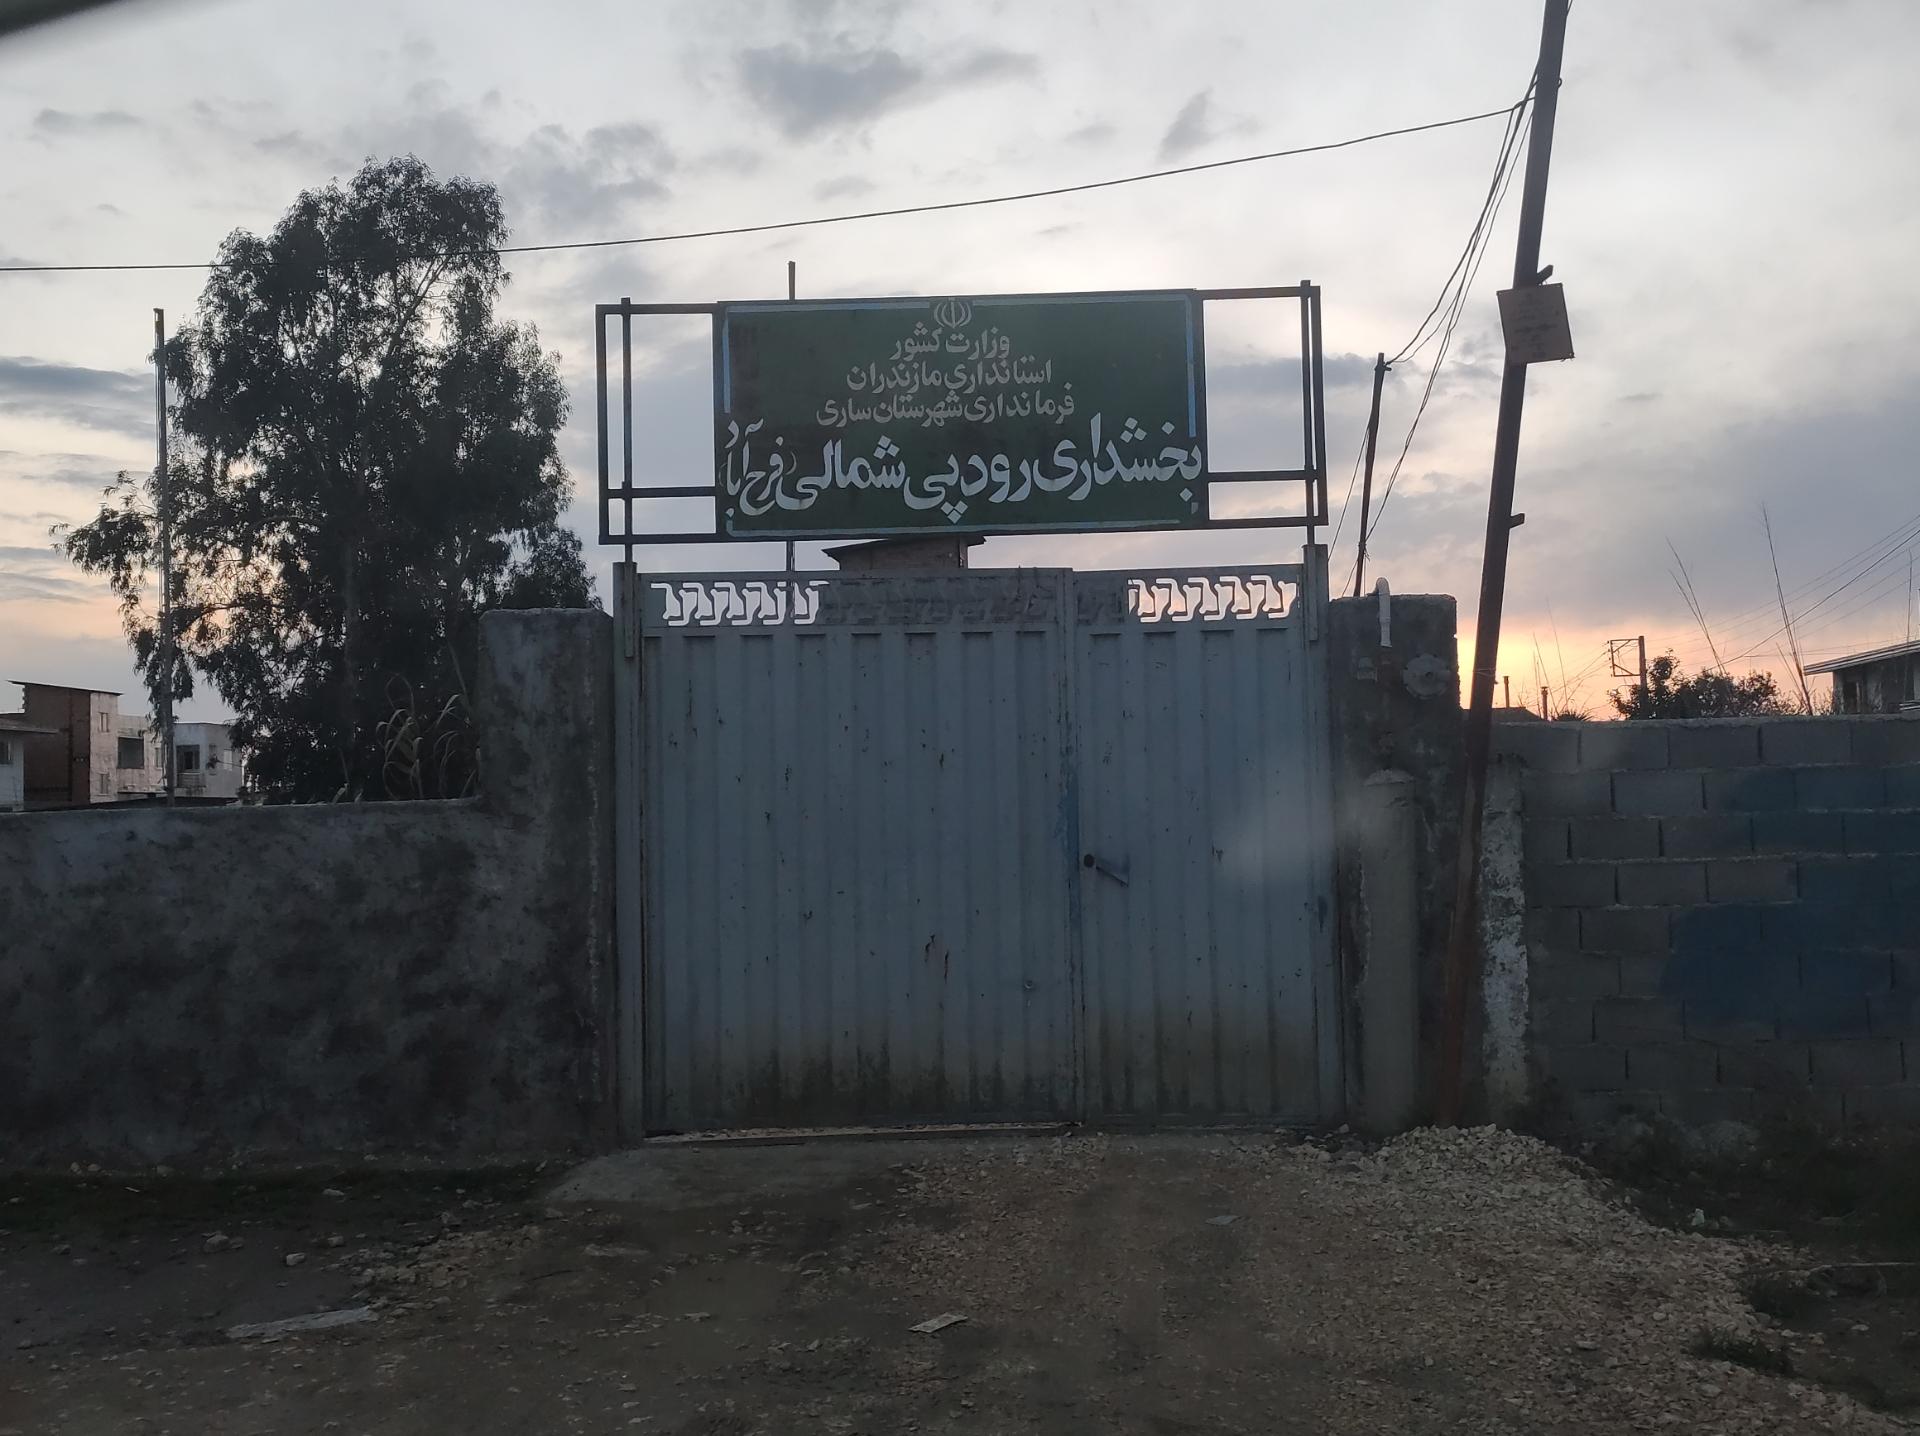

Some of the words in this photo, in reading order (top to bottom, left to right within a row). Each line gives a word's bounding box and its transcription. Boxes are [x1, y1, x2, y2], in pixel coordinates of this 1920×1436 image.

[889, 321, 943, 362] کشور
[946, 326, 1011, 360] وزارت
[846, 360, 943, 394] مازندران
[944, 354, 1052, 394] استانداری
[816, 398, 872, 428] ساری
[873, 389, 963, 427] شهرستان
[964, 381, 1076, 425] فرمانداری
[775, 434, 906, 511] شمالی
[1032, 412, 1202, 502] بخشداری
